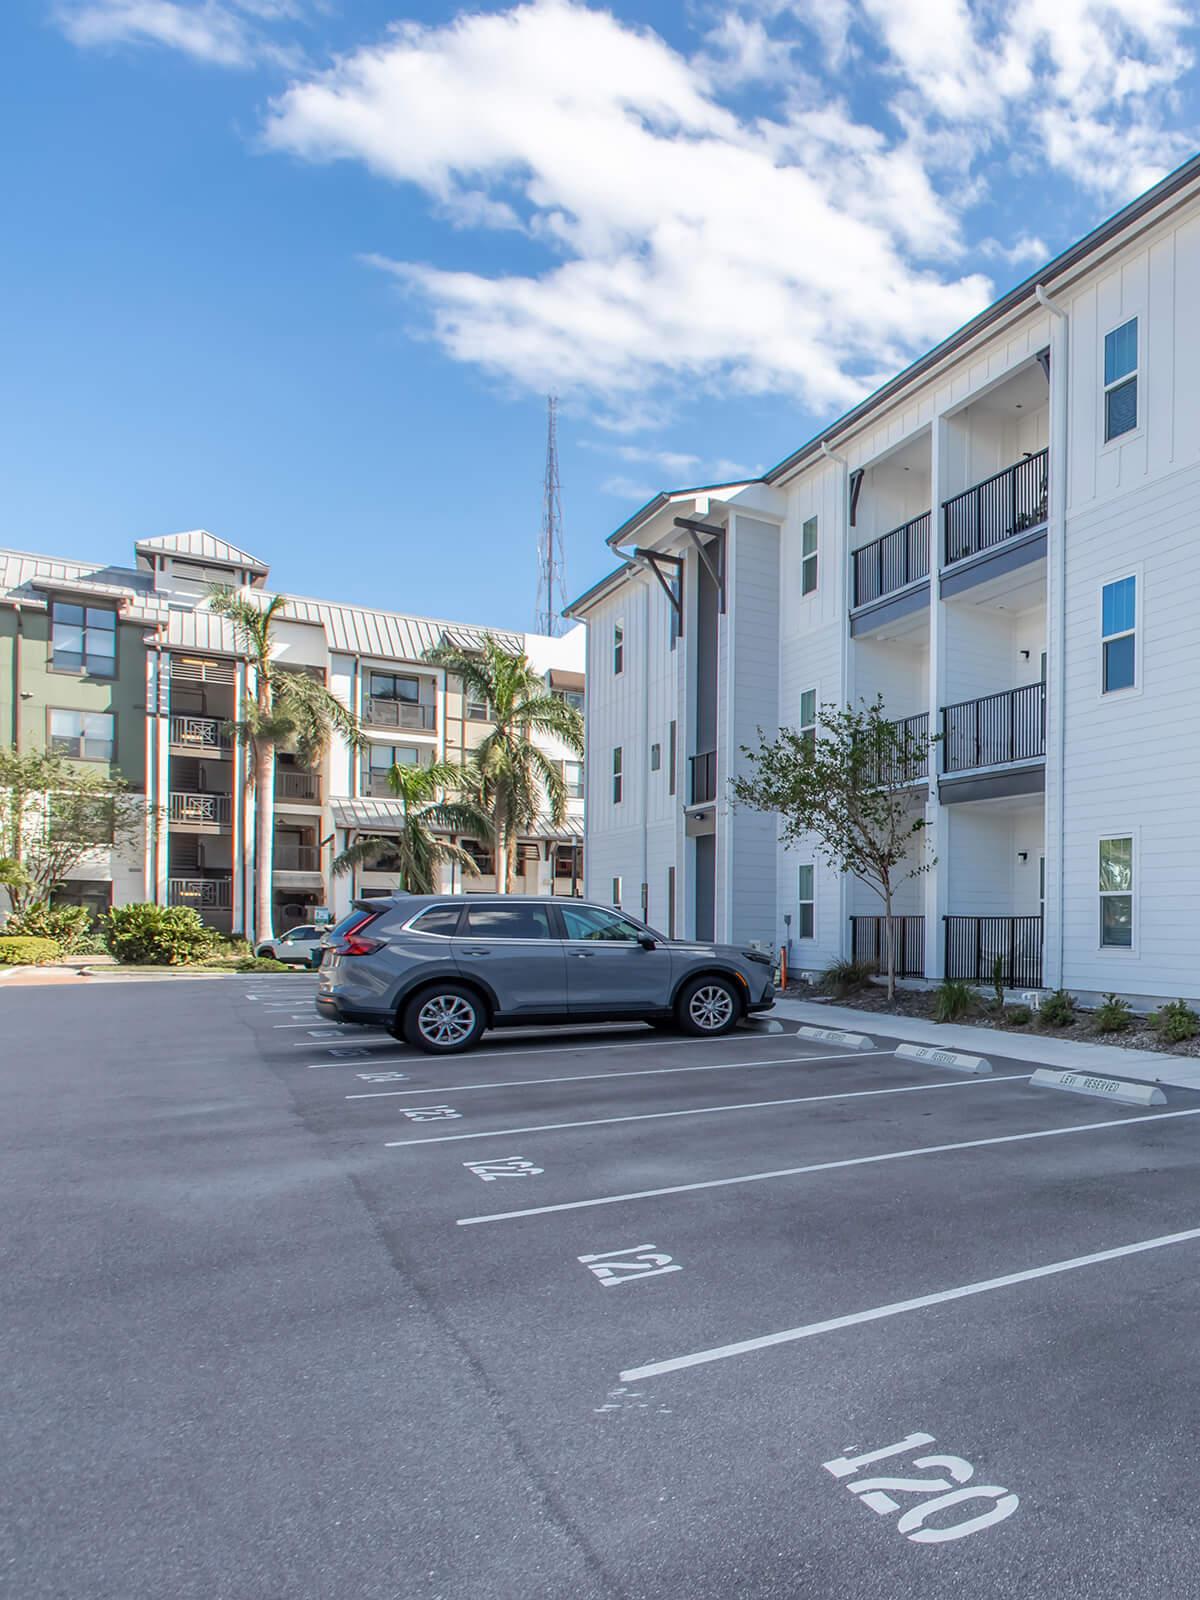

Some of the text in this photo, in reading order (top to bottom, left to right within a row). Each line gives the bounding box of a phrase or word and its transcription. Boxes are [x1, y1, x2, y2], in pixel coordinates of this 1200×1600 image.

[1084, 1078, 1120, 1092] RESERVED
[399, 1104, 463, 1122] 123
[462, 1155, 545, 1182] 122
[577, 1243, 683, 1288] 121
[821, 1431, 1020, 1544] 120
